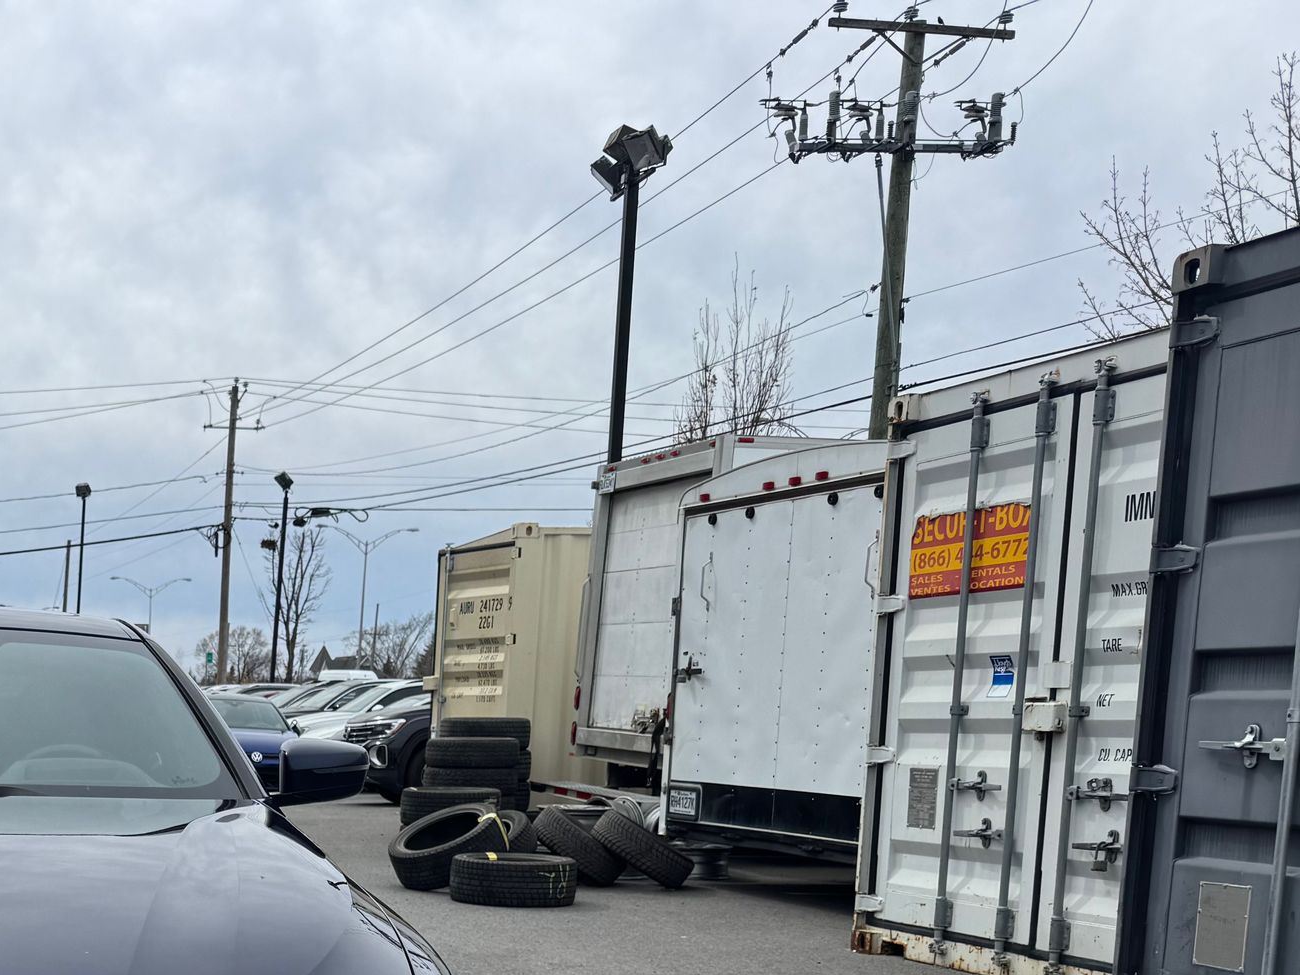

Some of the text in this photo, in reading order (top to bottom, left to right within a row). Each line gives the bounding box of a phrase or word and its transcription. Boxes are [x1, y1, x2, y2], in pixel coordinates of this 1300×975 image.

[913, 548, 951, 572] (866)
[911, 574, 943, 586] SALES
[971, 564, 1016, 578] ENTALS
[910, 584, 951, 596] VENTES
[480, 598, 503, 613] 241729
[1101, 638, 1123, 653] TARE
[1096, 693, 1115, 707] NET
[1098, 748, 1111, 762] CU.
